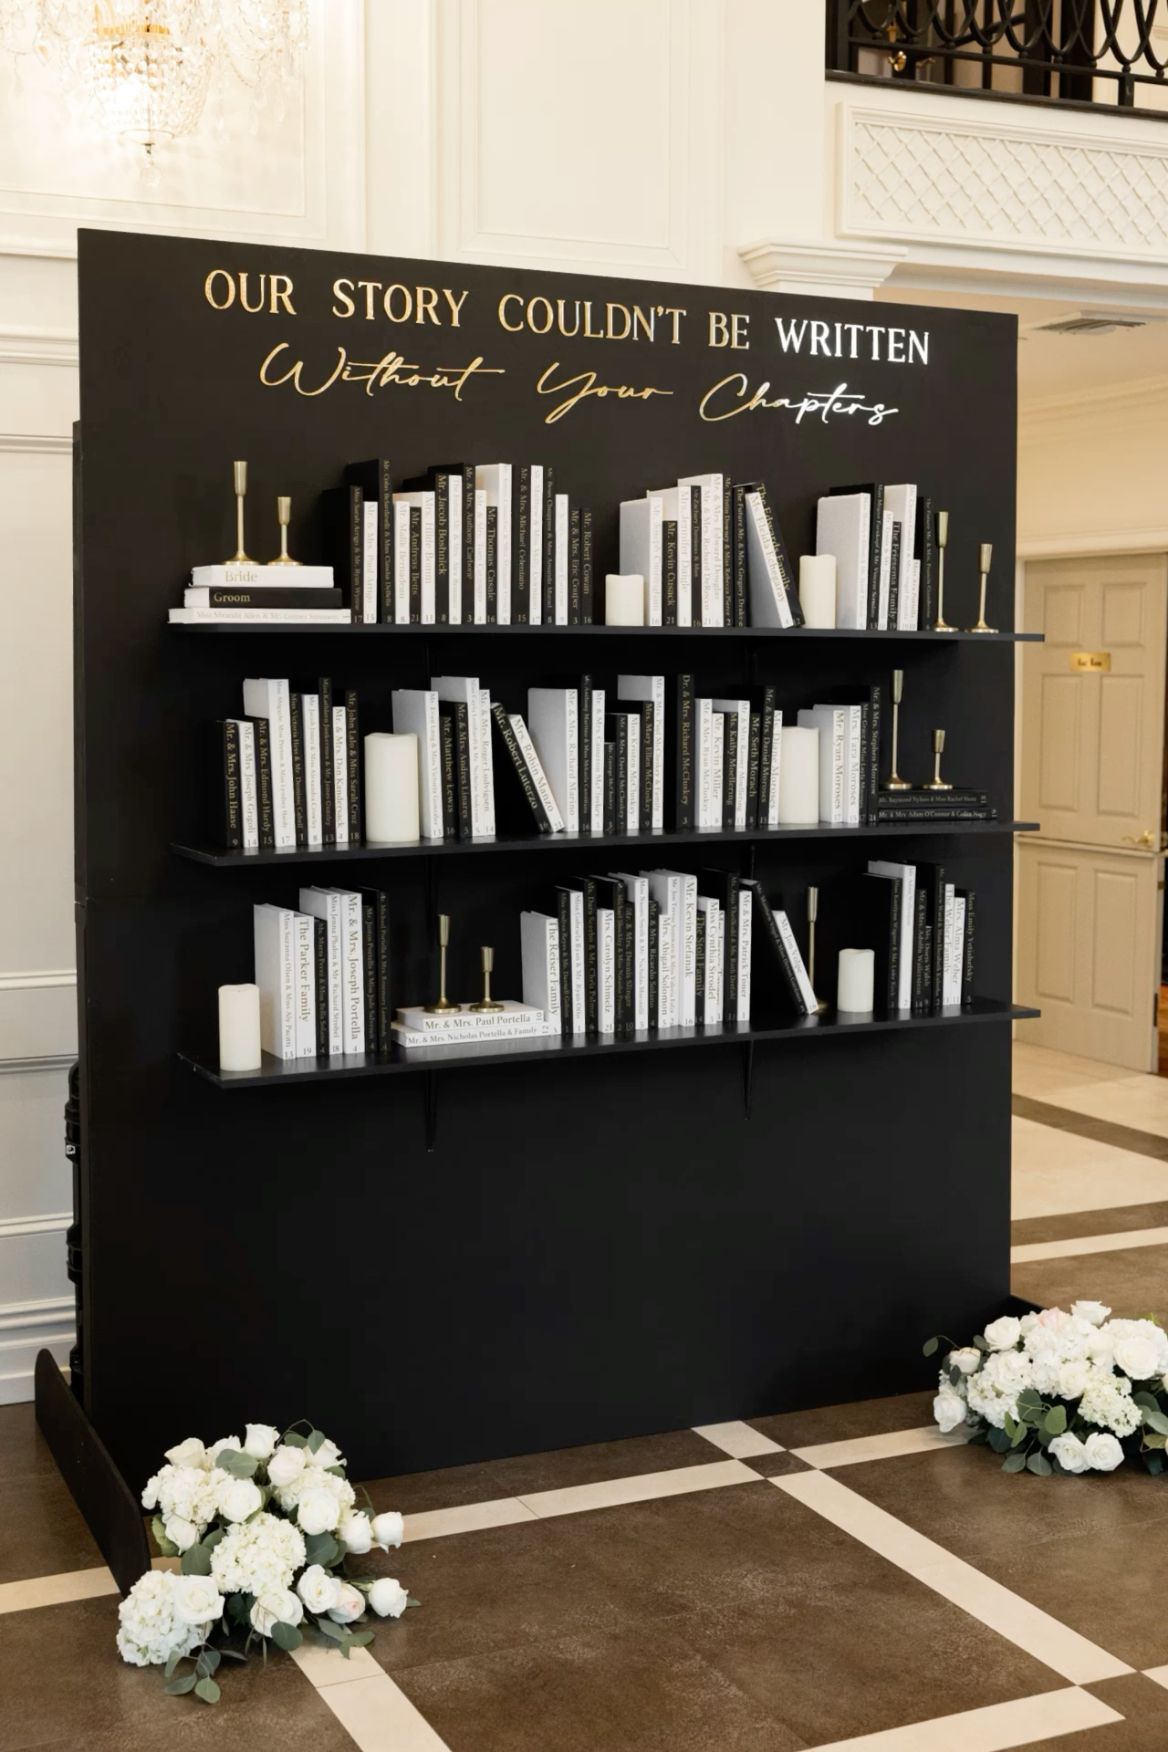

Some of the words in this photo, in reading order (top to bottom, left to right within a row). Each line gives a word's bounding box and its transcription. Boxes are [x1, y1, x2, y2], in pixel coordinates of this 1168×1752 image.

[205, 270, 296, 315] OUR
[333, 279, 469, 327] STORY
[499, 294, 686, 344] COULDN'T
[709, 312, 749, 349] BE
[775, 318, 929, 365] WRITTEN
[260, 343, 505, 401] Without
[537, 362, 673, 424] Your
[699, 373, 899, 425] Chapters
[439, 496, 447, 525] Jacob
[439, 529, 447, 575] Boshnick
[488, 529, 496, 566] Thomas
[764, 507, 781, 551] Edwards
[776, 555, 790, 590] Family
[225, 570, 258, 583] Bride
[668, 572, 676, 606] Cusack
[213, 591, 251, 603] Groom
[889, 587, 897, 619] Family
[348, 709, 356, 729] John
[260, 748, 268, 766] Mrs.
[445, 738, 453, 780] Matthew
[762, 737, 770, 765] Daniel
[835, 734, 843, 761] Ryan
[502, 729, 523, 766] Robert
[518, 768, 538, 809] Luterzo
[512, 718, 525, 740] Mrs.
[523, 744, 541, 775] Robin
[537, 777, 554, 812] Manzo
[227, 776, 236, 798] John
[243, 774, 254, 801] Joseph
[261, 769, 269, 804] Edmond
[350, 779, 358, 802] Sarah
[681, 758, 690, 805] McCluskey
[447, 784, 455, 813] Lewis
[569, 781, 577, 816] Marino
[229, 801, 238, 829] Haase
[261, 806, 270, 832] Hardy
[662, 917, 670, 937] Mrs.
[686, 903, 694, 932] Kevin
[350, 930, 359, 955] Mrs.
[661, 941, 670, 972] Abigail
[685, 934, 694, 977] Stefanak
[708, 926, 717, 964] Cynthia
[300, 944, 310, 981] Parker
[347, 957, 360, 994] Joseph
[550, 944, 559, 976] Reiser
[550, 980, 559, 1015] Family
[708, 966, 716, 1000] Strodel
[299, 984, 310, 1022] Family
[351, 997, 361, 1039] Portella
[408, 1037, 421, 1045] Mr.
[448, 1032, 477, 1040] Nicholas
[479, 1030, 505, 1038] Portella
[514, 1027, 537, 1035] Family
[425, 1021, 442, 1030] Mr.
[443, 1020, 450, 1028] &
[454, 1019, 472, 1028] Mrs.
[476, 1017, 494, 1026] Paul
[497, 1014, 530, 1024] Portella
